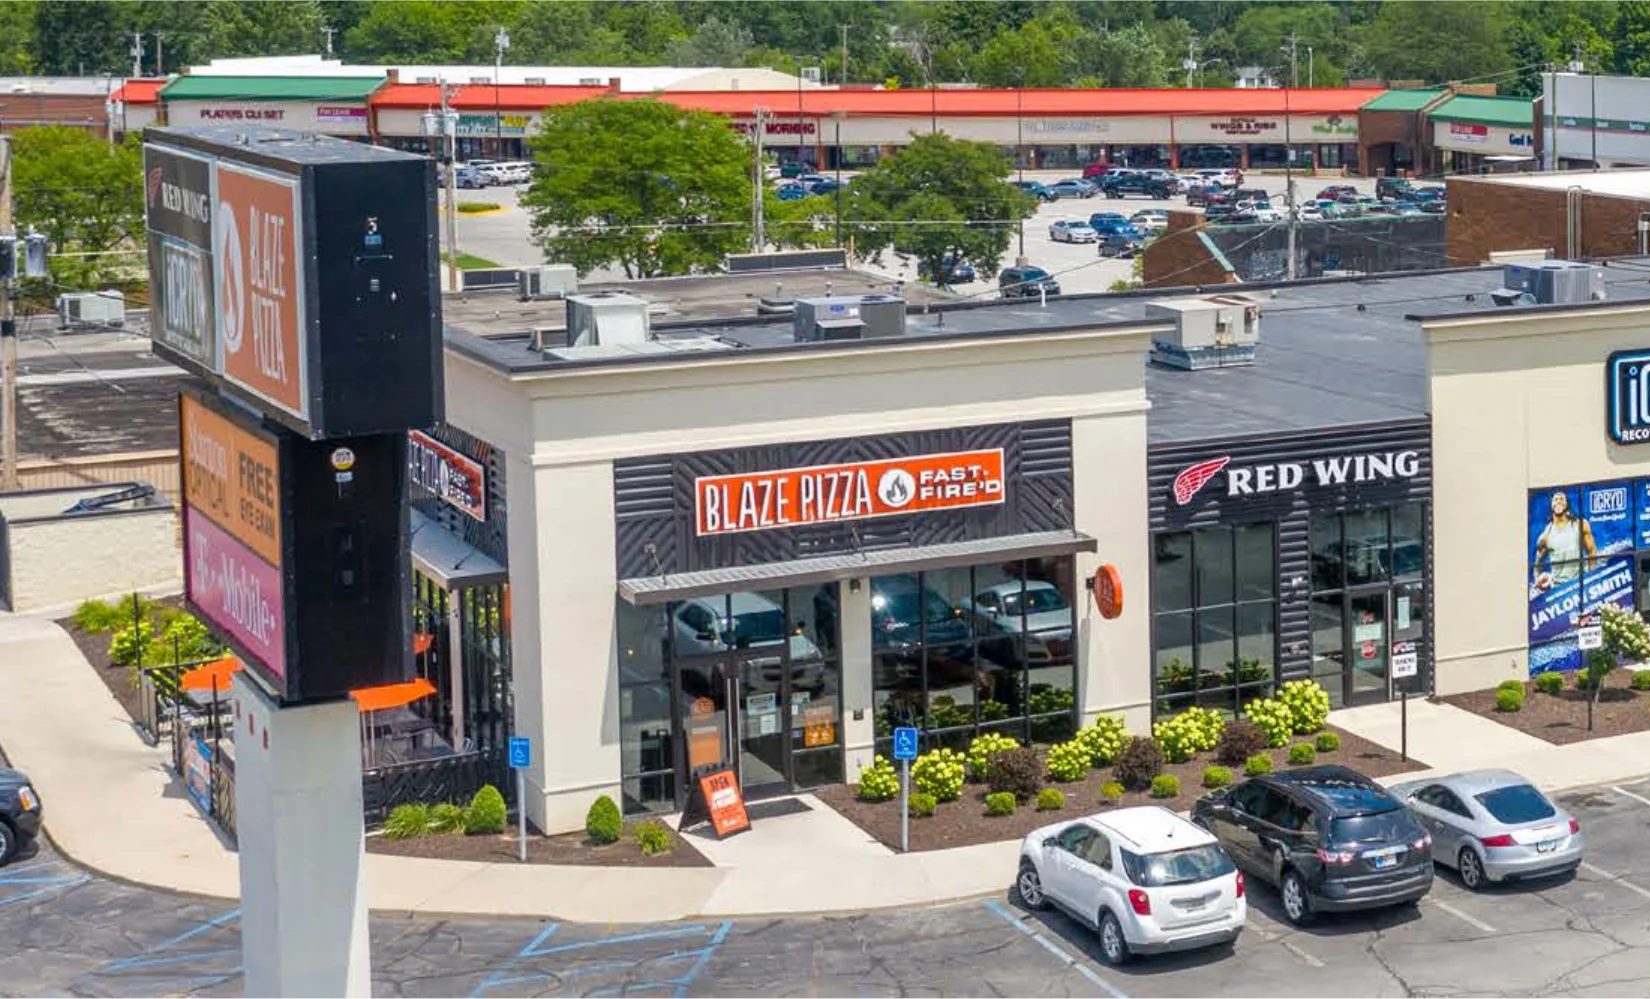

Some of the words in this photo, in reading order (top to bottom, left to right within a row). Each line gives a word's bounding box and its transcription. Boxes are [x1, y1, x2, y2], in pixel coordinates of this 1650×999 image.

[162, 183, 181, 212] RED
[182, 187, 209, 223] WING
[251, 206, 285, 297] BLAZE
[252, 291, 287, 386] PIZZA
[239, 452, 274, 508] FREE
[705, 477, 789, 532] BLAZE
[801, 469, 873, 521] PIZZA
[919, 480, 1002, 499] FIRE'D
[1228, 463, 1303, 497] RED
[1312, 451, 1419, 487] WING
[1532, 592, 1588, 631] JAYLON
[1589, 569, 1633, 600] SMITH
